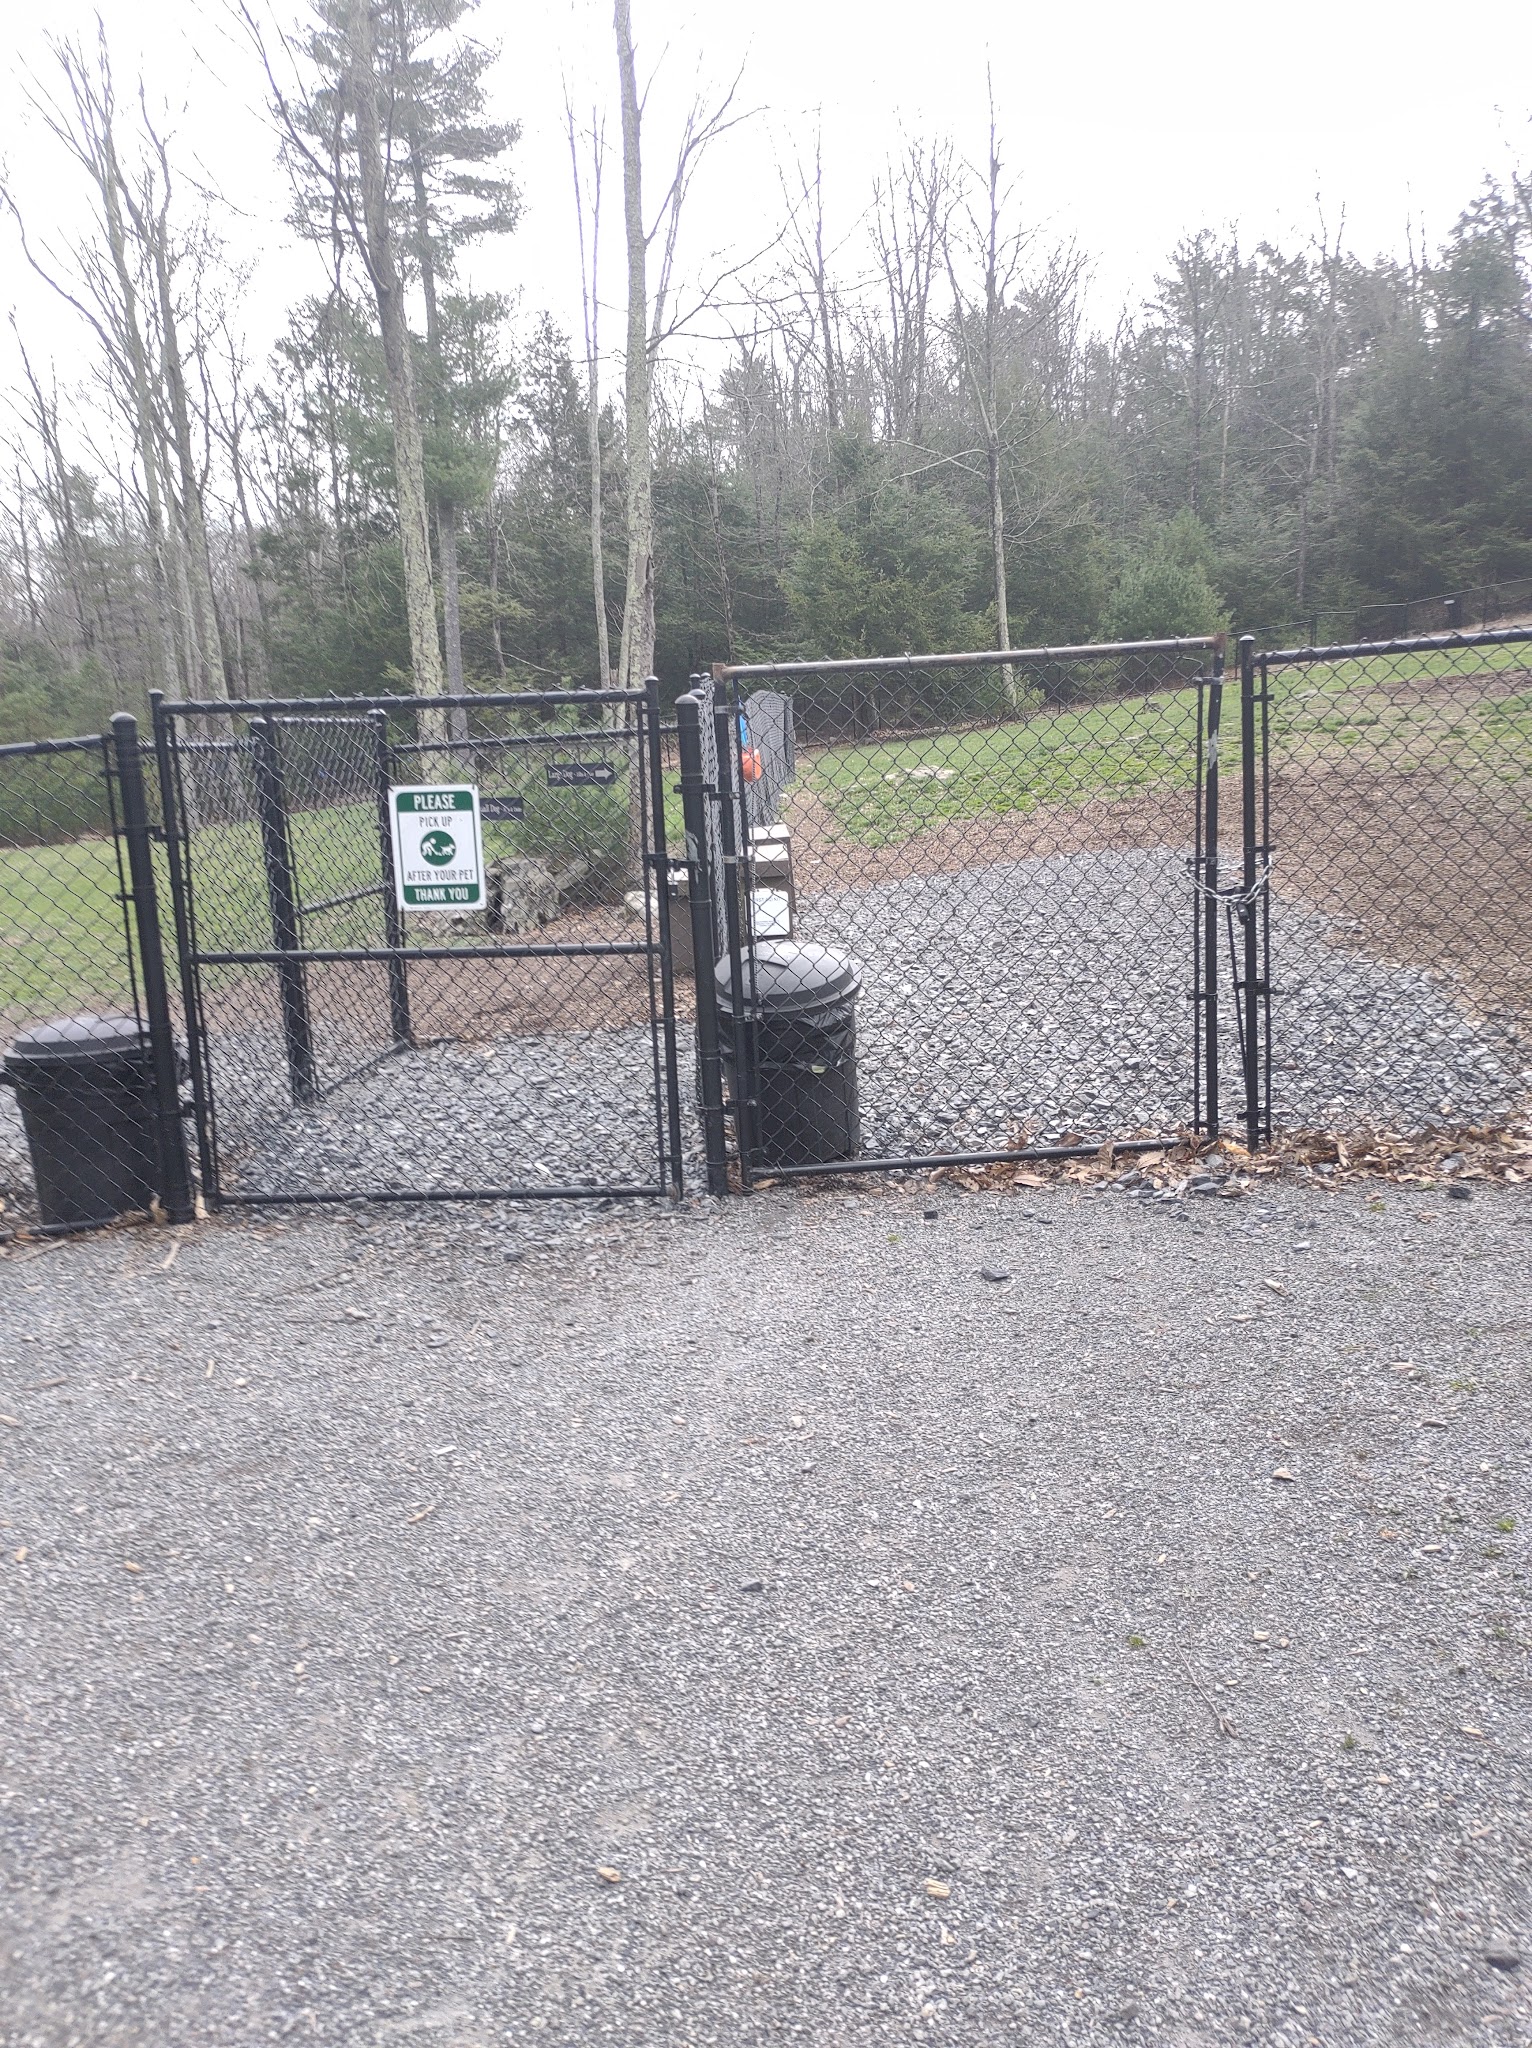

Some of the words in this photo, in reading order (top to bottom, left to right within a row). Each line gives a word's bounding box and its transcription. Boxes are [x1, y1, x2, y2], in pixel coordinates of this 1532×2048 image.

[414, 794, 456, 810] PLEASE
[419, 816, 439, 828] PICK
[441, 816, 453, 827] UP
[407, 870, 432, 882] AFTER
[435, 870, 458, 881] YOUR
[460, 869, 473, 880] PET
[414, 888, 446, 901] THANK
[448, 887, 469, 900] YOU
